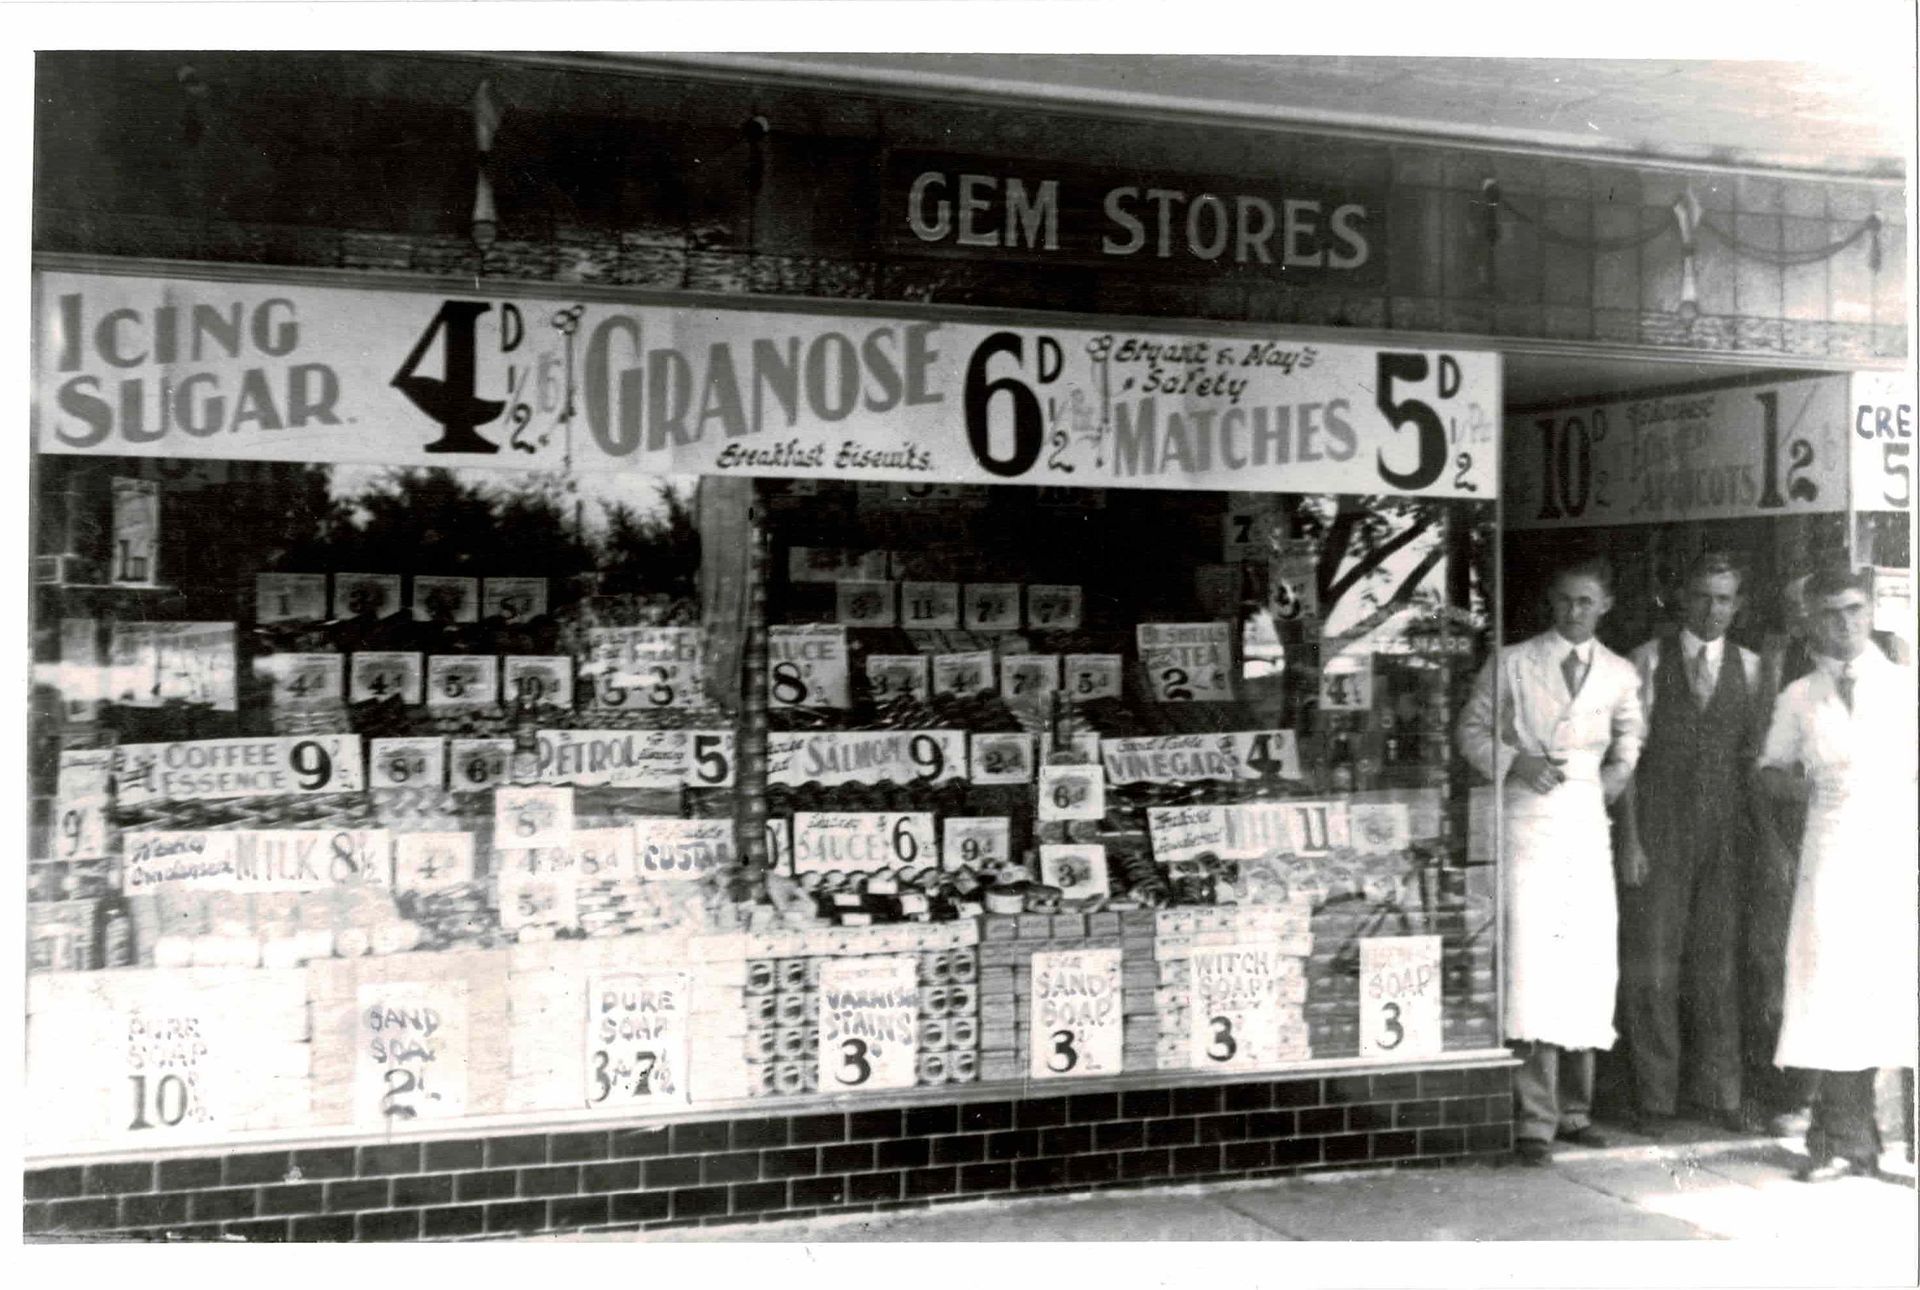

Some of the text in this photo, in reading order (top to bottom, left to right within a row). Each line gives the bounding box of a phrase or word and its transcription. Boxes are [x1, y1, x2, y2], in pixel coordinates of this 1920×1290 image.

[907, 171, 1370, 269] GEM STORES
[57, 294, 300, 372] ICING
[1114, 337, 1209, 369] Bryant
[583, 314, 945, 457] GRANOSE
[1141, 366, 1248, 405] Safety
[1112, 399, 1357, 478] MATCHES
[1882, 442, 1911, 510] 5
[162, 743, 279, 769] COFFEE
[537, 735, 640, 777] PETROL
[159, 769, 287, 797] ESSENCE
[795, 831, 880, 863] SAUCE
[601, 989, 676, 1014] PURE
